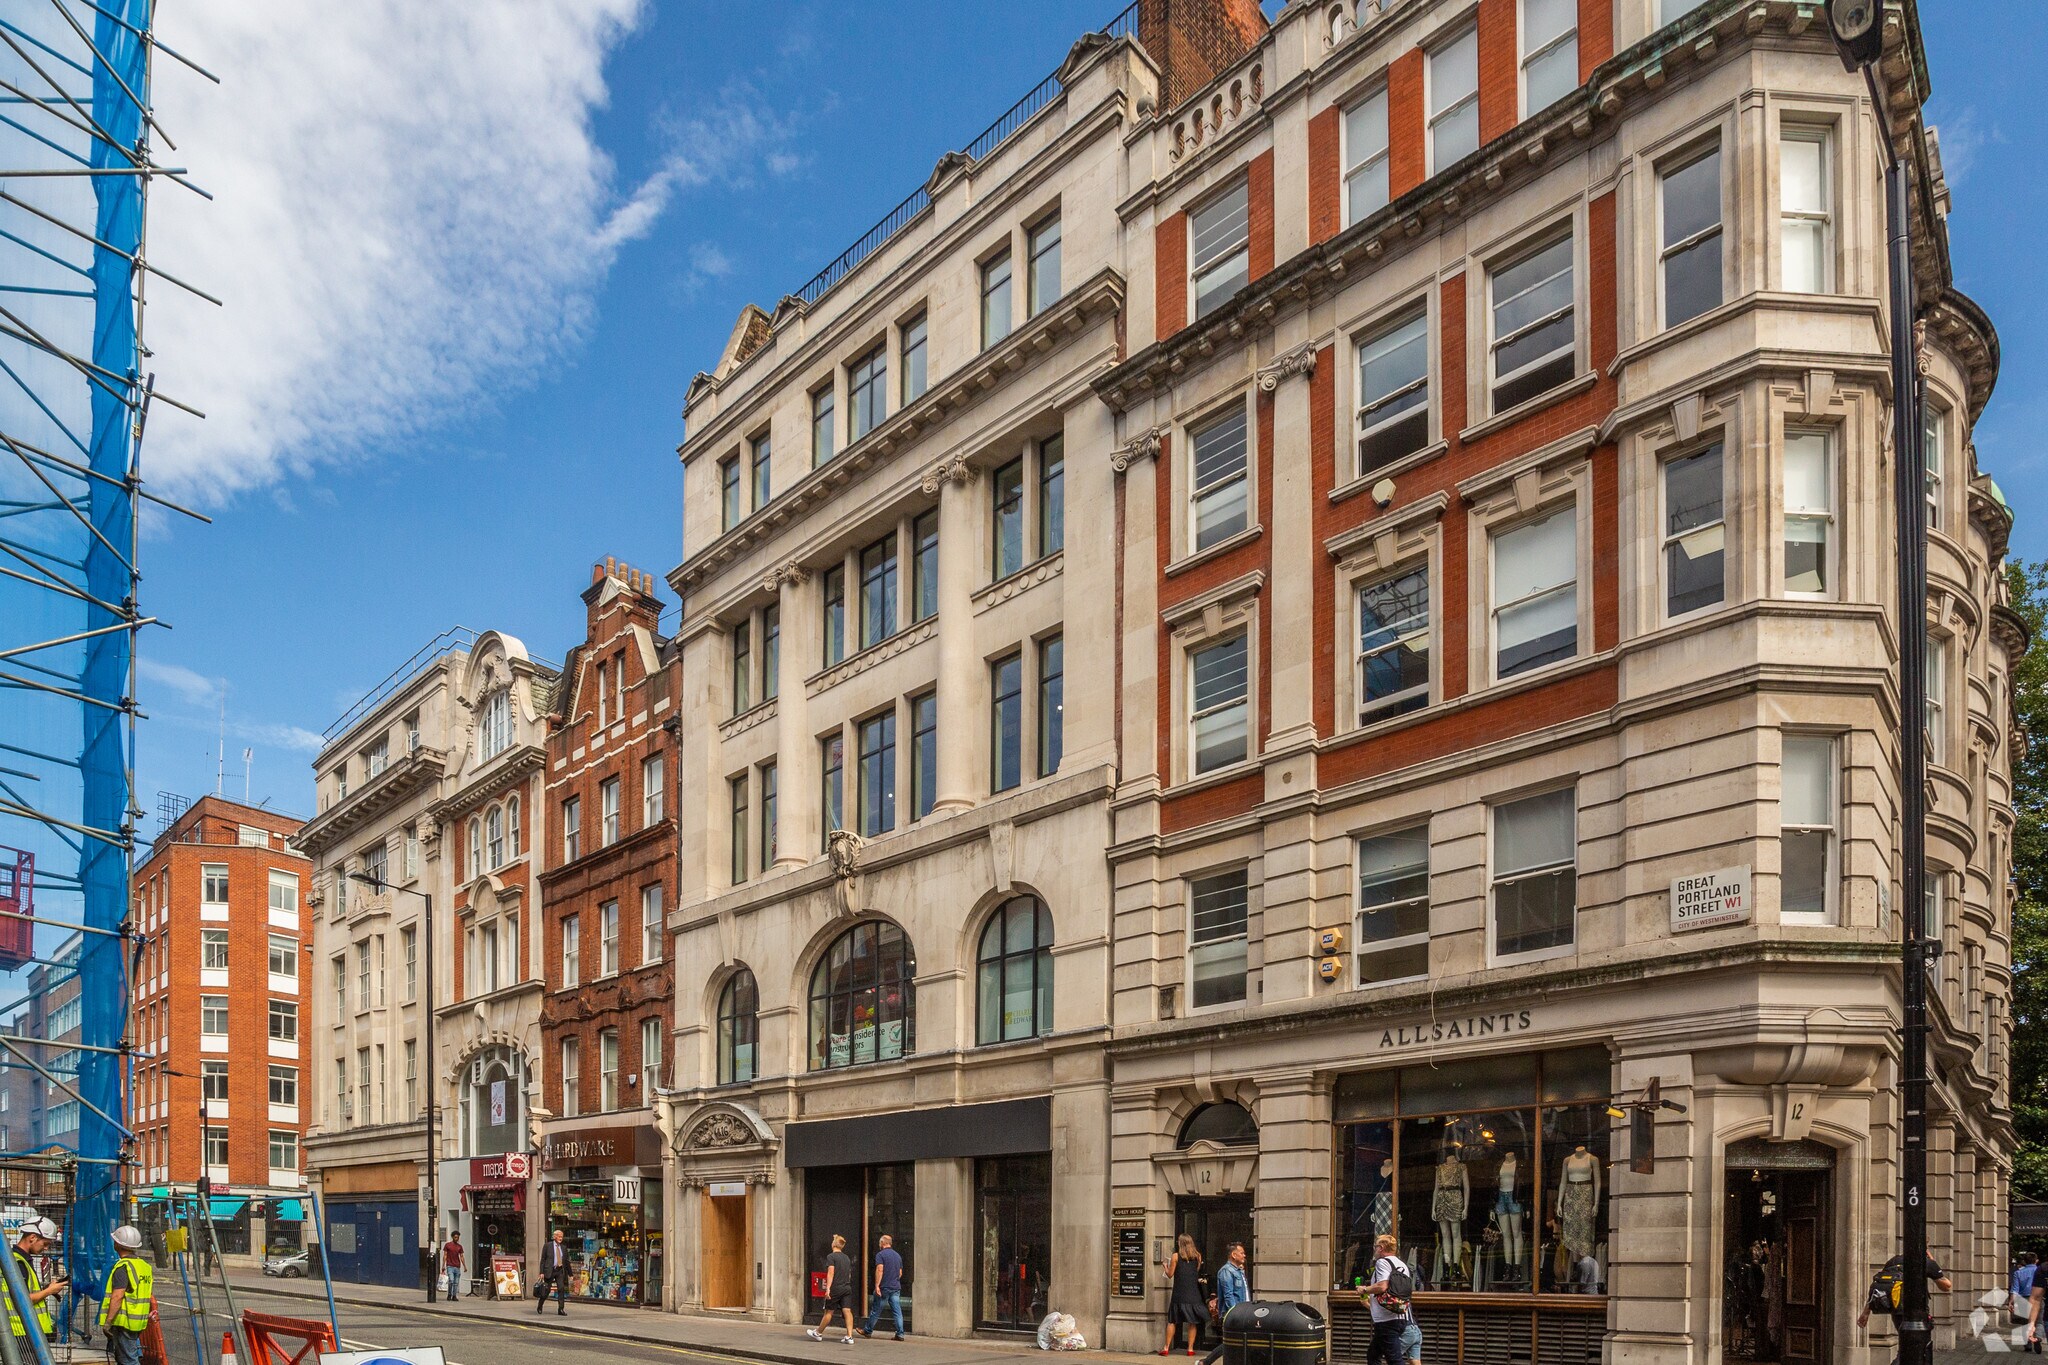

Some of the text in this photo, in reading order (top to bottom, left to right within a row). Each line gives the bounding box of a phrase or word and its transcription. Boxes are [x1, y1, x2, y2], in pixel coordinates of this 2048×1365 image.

[1678, 875, 1716, 892] GREAT
[1678, 883, 1741, 905] PORTLAND
[1678, 895, 1742, 918] STREET W1
[1678, 913, 1739, 930] CITY OF WESTMINSTER
[1379, 1010, 1531, 1048] ALLSAINTS
[1791, 1103, 1804, 1120] 12
[555, 1139, 615, 1159] HARDWARE
[483, 1162, 505, 1178] mapa
[1201, 1170, 1211, 1184] 12
[616, 1180, 639, 1200] DIY
